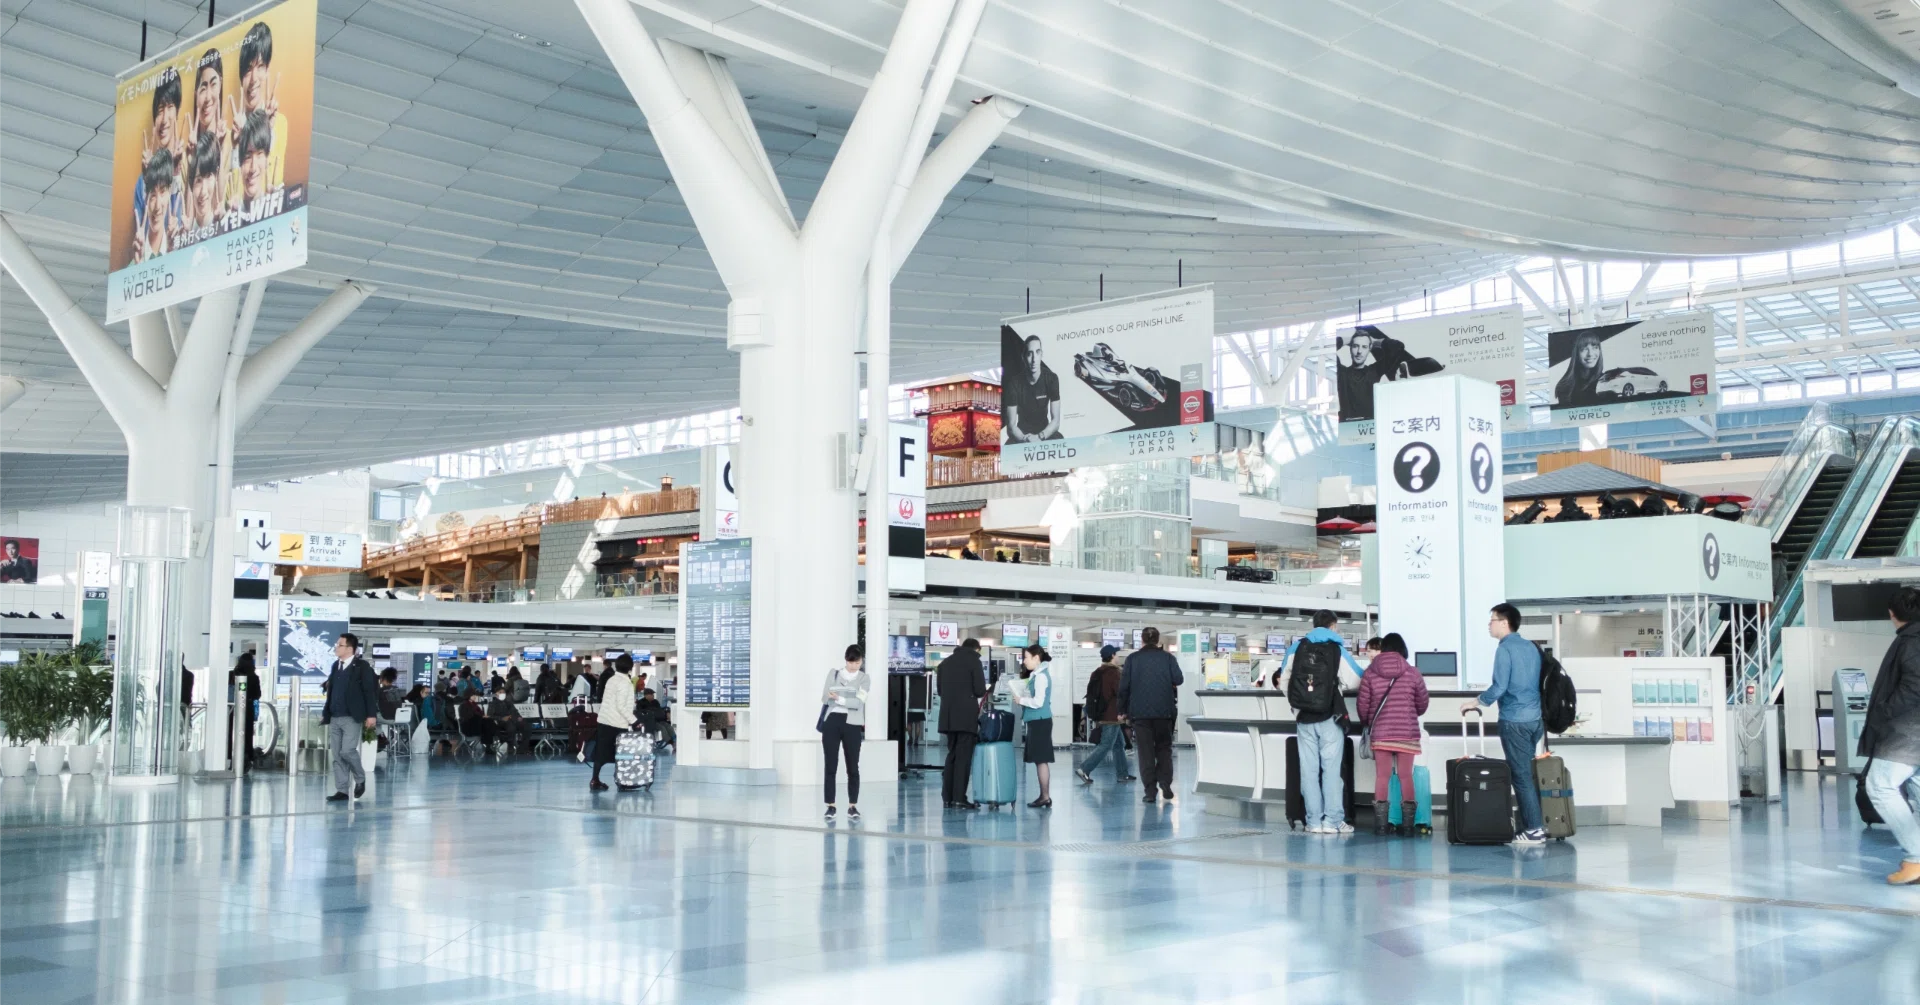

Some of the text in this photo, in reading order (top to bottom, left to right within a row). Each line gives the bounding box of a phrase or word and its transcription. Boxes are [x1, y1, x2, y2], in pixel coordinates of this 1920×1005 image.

[227, 227, 274, 251] HANEDA
[227, 240, 274, 263] TOKYO
[226, 253, 273, 276] JAPAN
[123, 264, 165, 285] FLY TO THE
[123, 272, 174, 302] WORLD
[1056, 325, 1105, 342] INNOVATION
[1106, 325, 1114, 333] IS
[1115, 321, 1134, 332] OUR
[1135, 317, 1163, 329] FINISH
[1448, 324, 1485, 336] Driving
[1641, 325, 1706, 340] Leave nothing
[1449, 331, 1507, 348] reinvented.
[1650, 398, 1686, 406] HANEDA
[1568, 411, 1611, 421] WORLD
[1651, 408, 1687, 416] JAPAN
[1392, 415, 1441, 434] ご案内
[1468, 416, 1494, 437] ご案内
[1129, 429, 1174, 441] HANEDA
[1023, 445, 1038, 453] FLY
[1129, 437, 1175, 448] TOKYO
[899, 436, 915, 478] F
[1024, 448, 1077, 462] WORLD
[1129, 444, 1175, 456] JAPAN
[1388, 499, 1448, 512] Information
[1467, 499, 1498, 512] Information
[309, 535, 347, 547] 到着 2F
[309, 546, 342, 555] Arrivals
[1721, 552, 1769, 571] ご案内 Information
[285, 602, 301, 617] 3F
